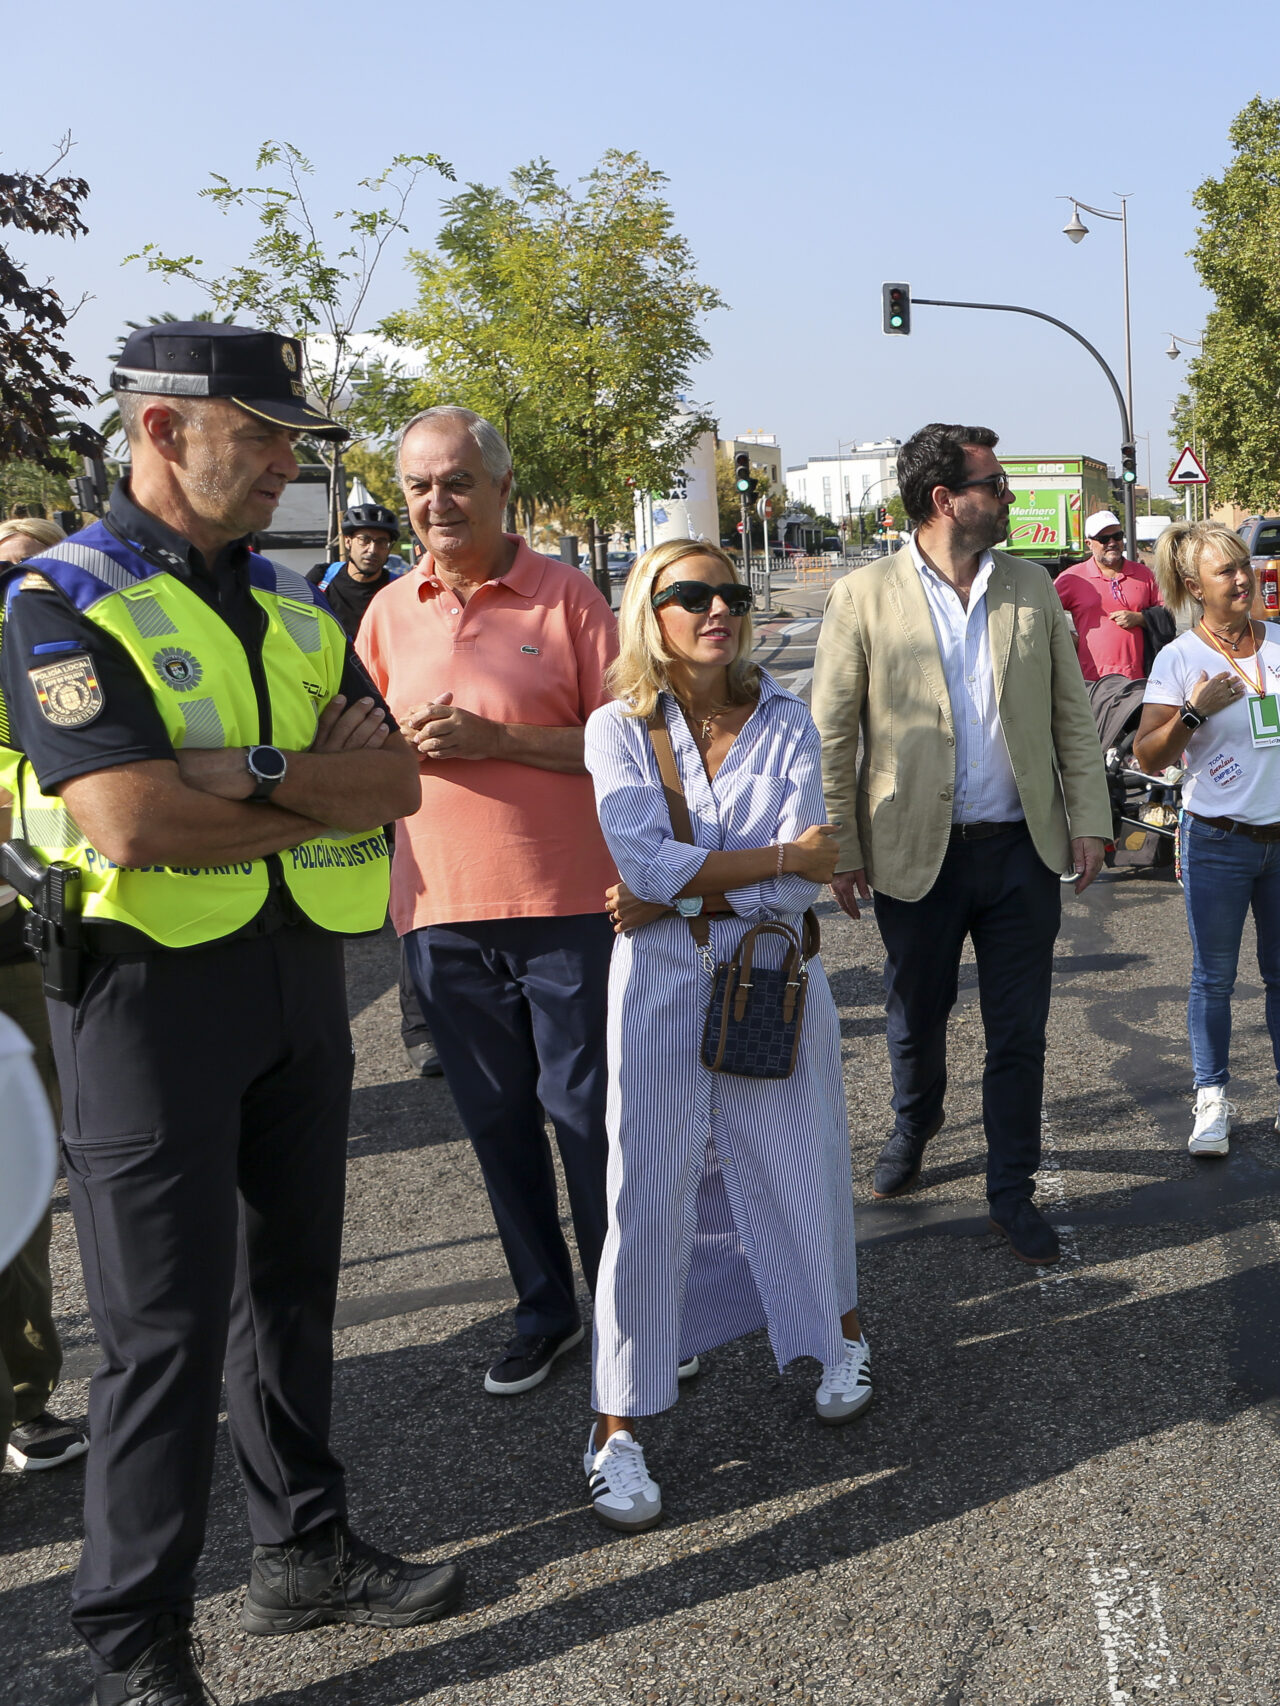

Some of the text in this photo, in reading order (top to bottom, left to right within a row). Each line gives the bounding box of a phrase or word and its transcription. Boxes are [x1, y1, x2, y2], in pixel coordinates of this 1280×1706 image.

[1009, 507, 1056, 516] Merinero
[62, 661, 89, 673] LOCAL
[1252, 700, 1278, 735] L
[289, 839, 334, 869] POLICÍA
